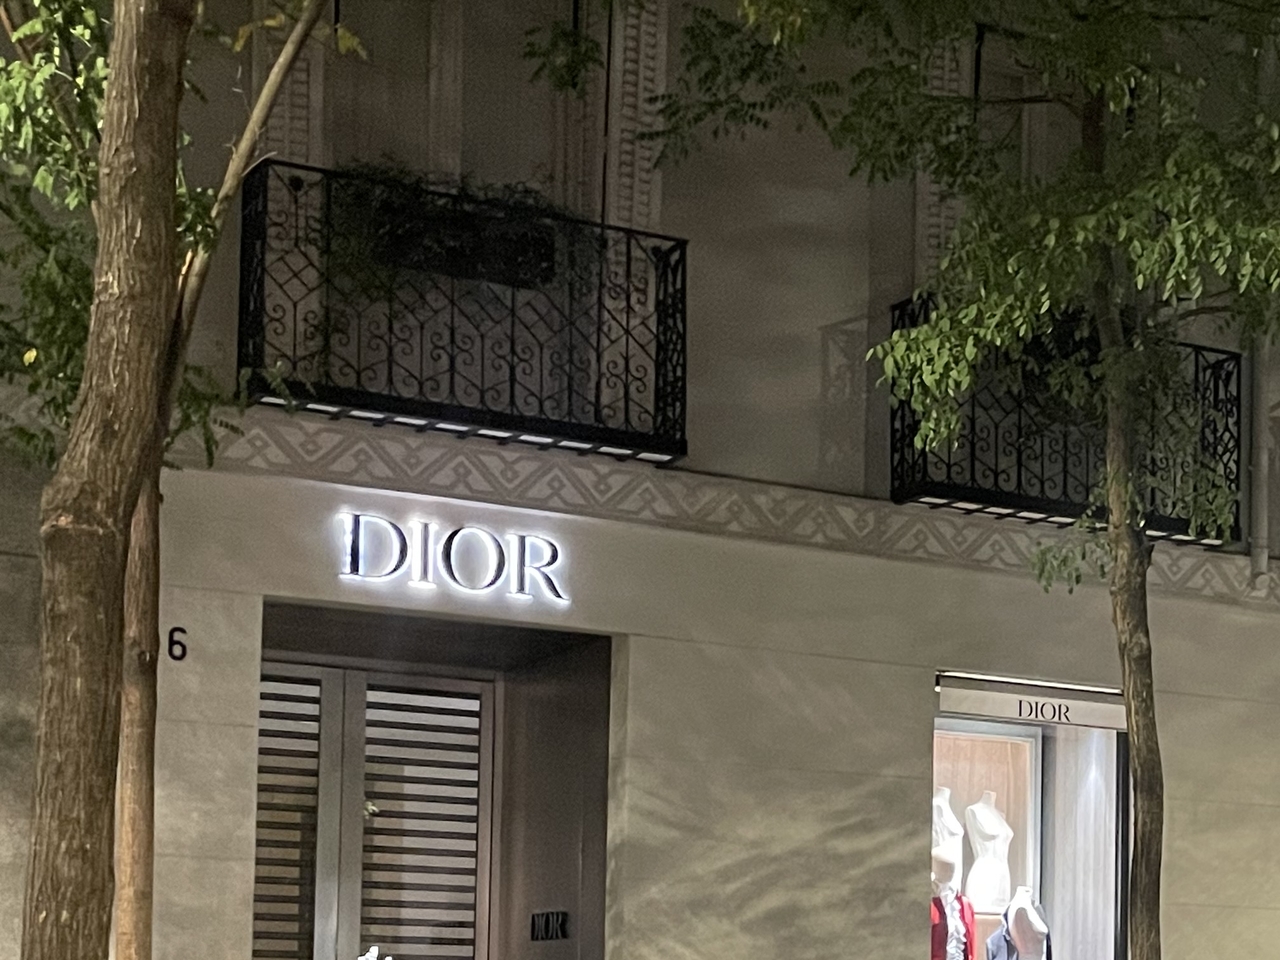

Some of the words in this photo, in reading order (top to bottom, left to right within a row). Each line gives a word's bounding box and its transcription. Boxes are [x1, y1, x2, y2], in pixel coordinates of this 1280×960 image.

[338, 511, 571, 603] DIOR
[168, 626, 188, 661] 6
[1018, 699, 1071, 722] DIOR
[530, 911, 569, 941] DIOR
